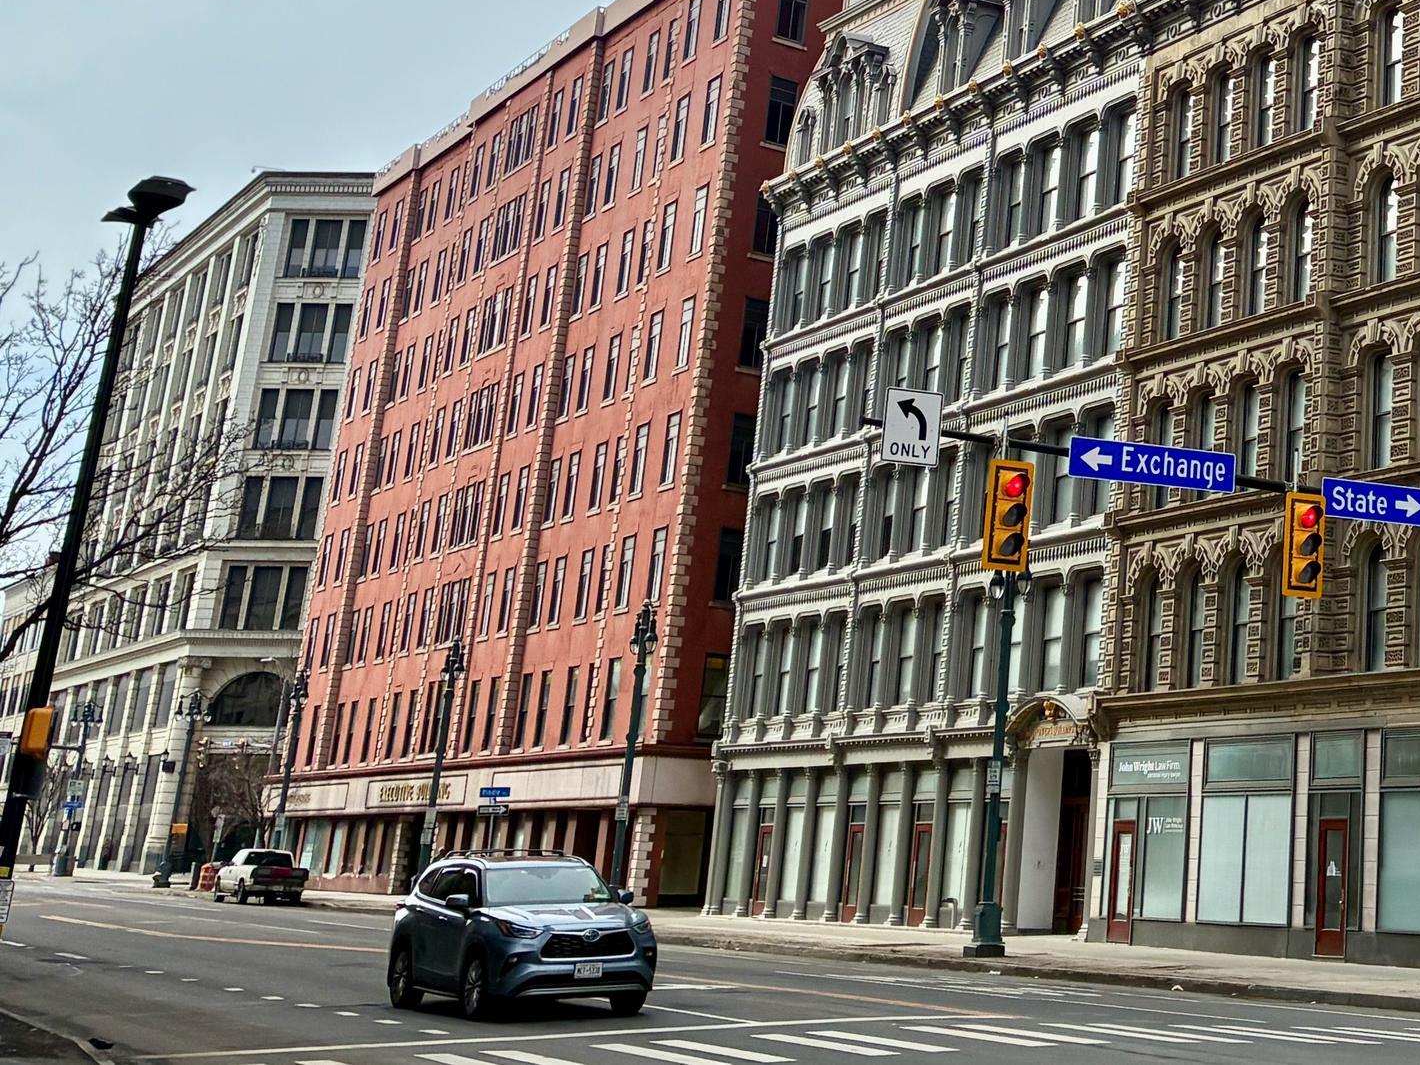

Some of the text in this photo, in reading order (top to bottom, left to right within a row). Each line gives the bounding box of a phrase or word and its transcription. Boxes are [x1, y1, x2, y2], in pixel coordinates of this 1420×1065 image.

[890, 442, 931, 459] ONLY
[1121, 446, 1226, 489] Exchange
[1332, 486, 1388, 515] State
[1118, 759, 1181, 775] John Wright Law Firm
[380, 784, 415, 803] EXECUTIVE
[1146, 816, 1164, 834] JW
